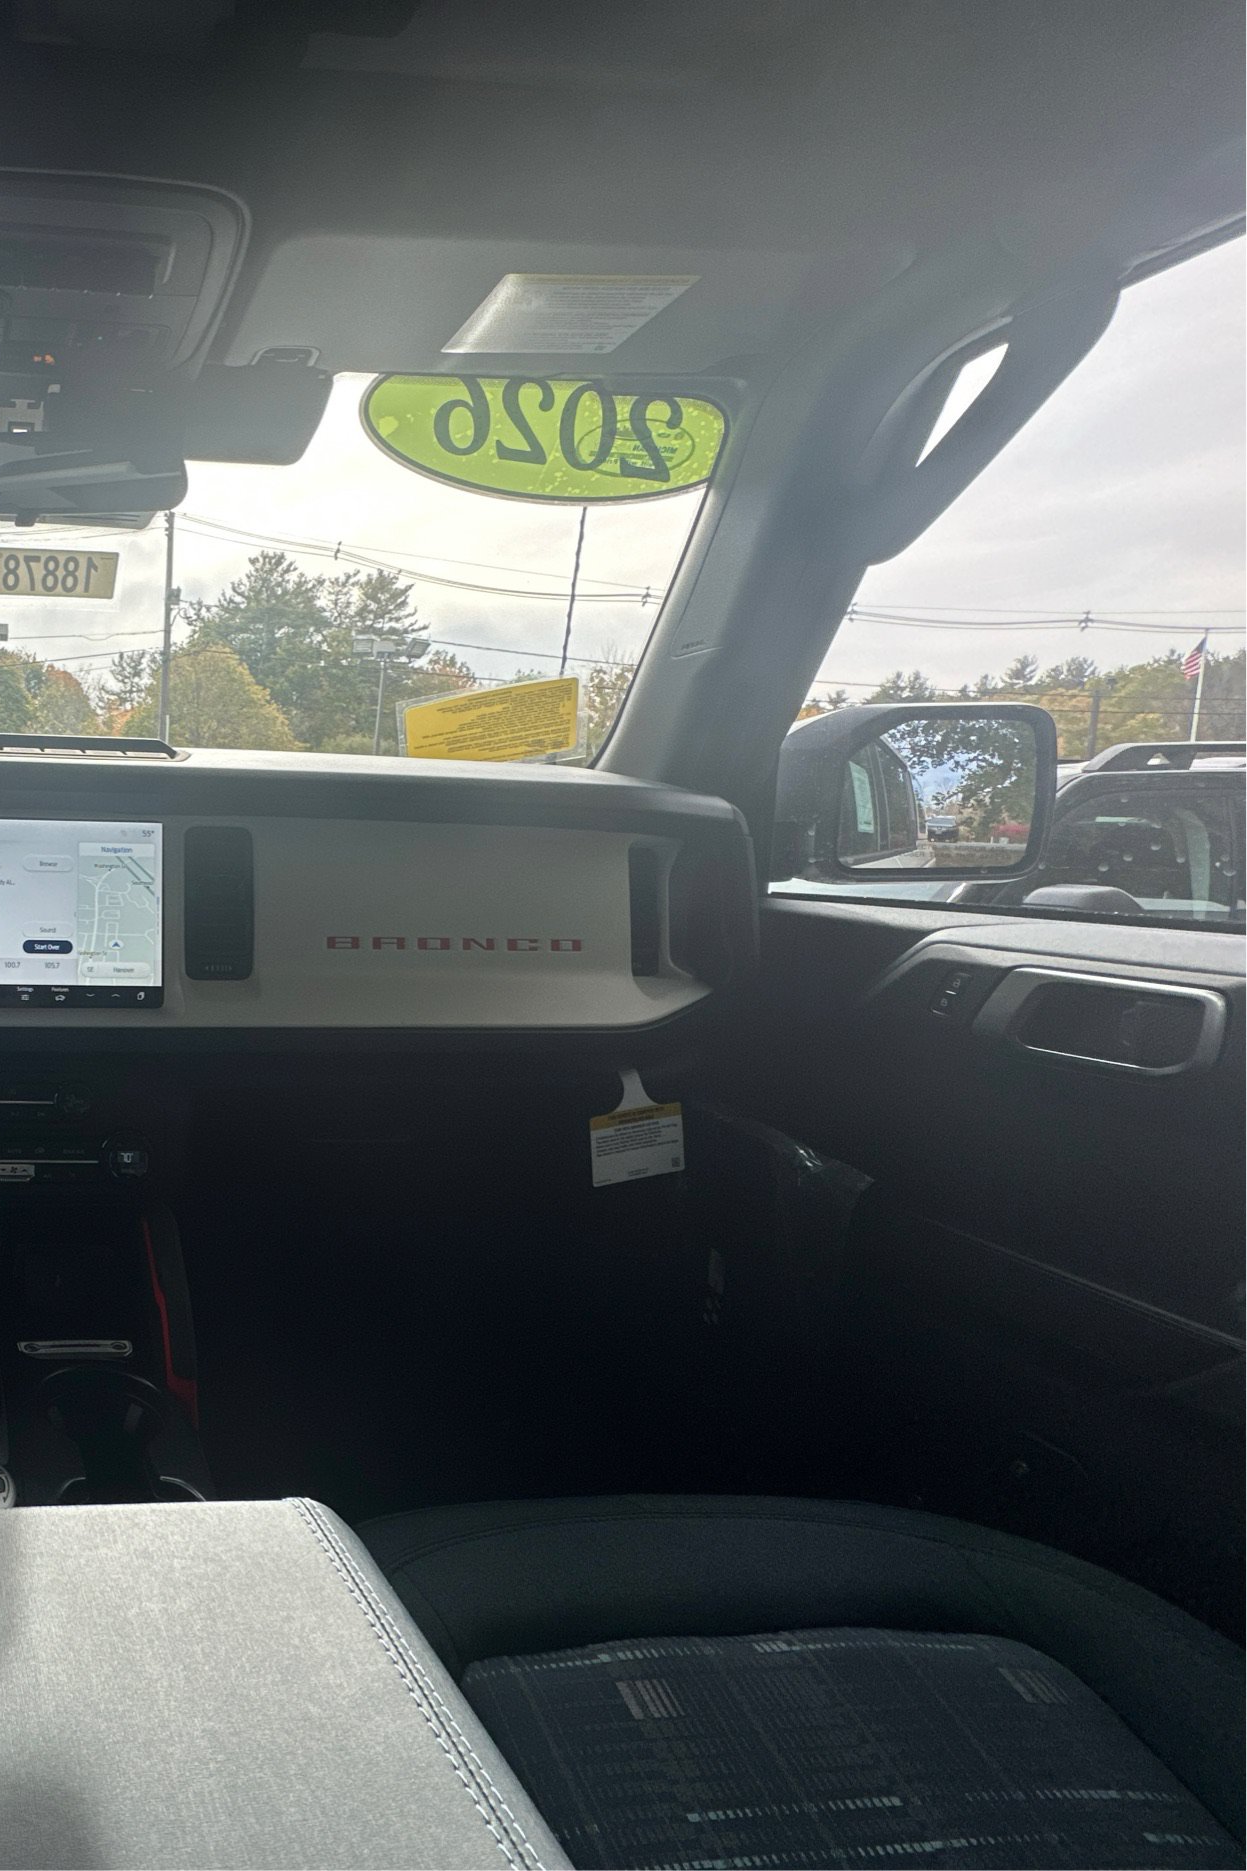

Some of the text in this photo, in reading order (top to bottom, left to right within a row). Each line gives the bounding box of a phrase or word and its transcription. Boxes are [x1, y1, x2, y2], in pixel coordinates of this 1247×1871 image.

[101, 846, 133, 855] Navigation
[34, 943, 60, 951] Start Over
[326, 935, 584, 952] BRONCO
[4, 961, 21, 969] 100.7
